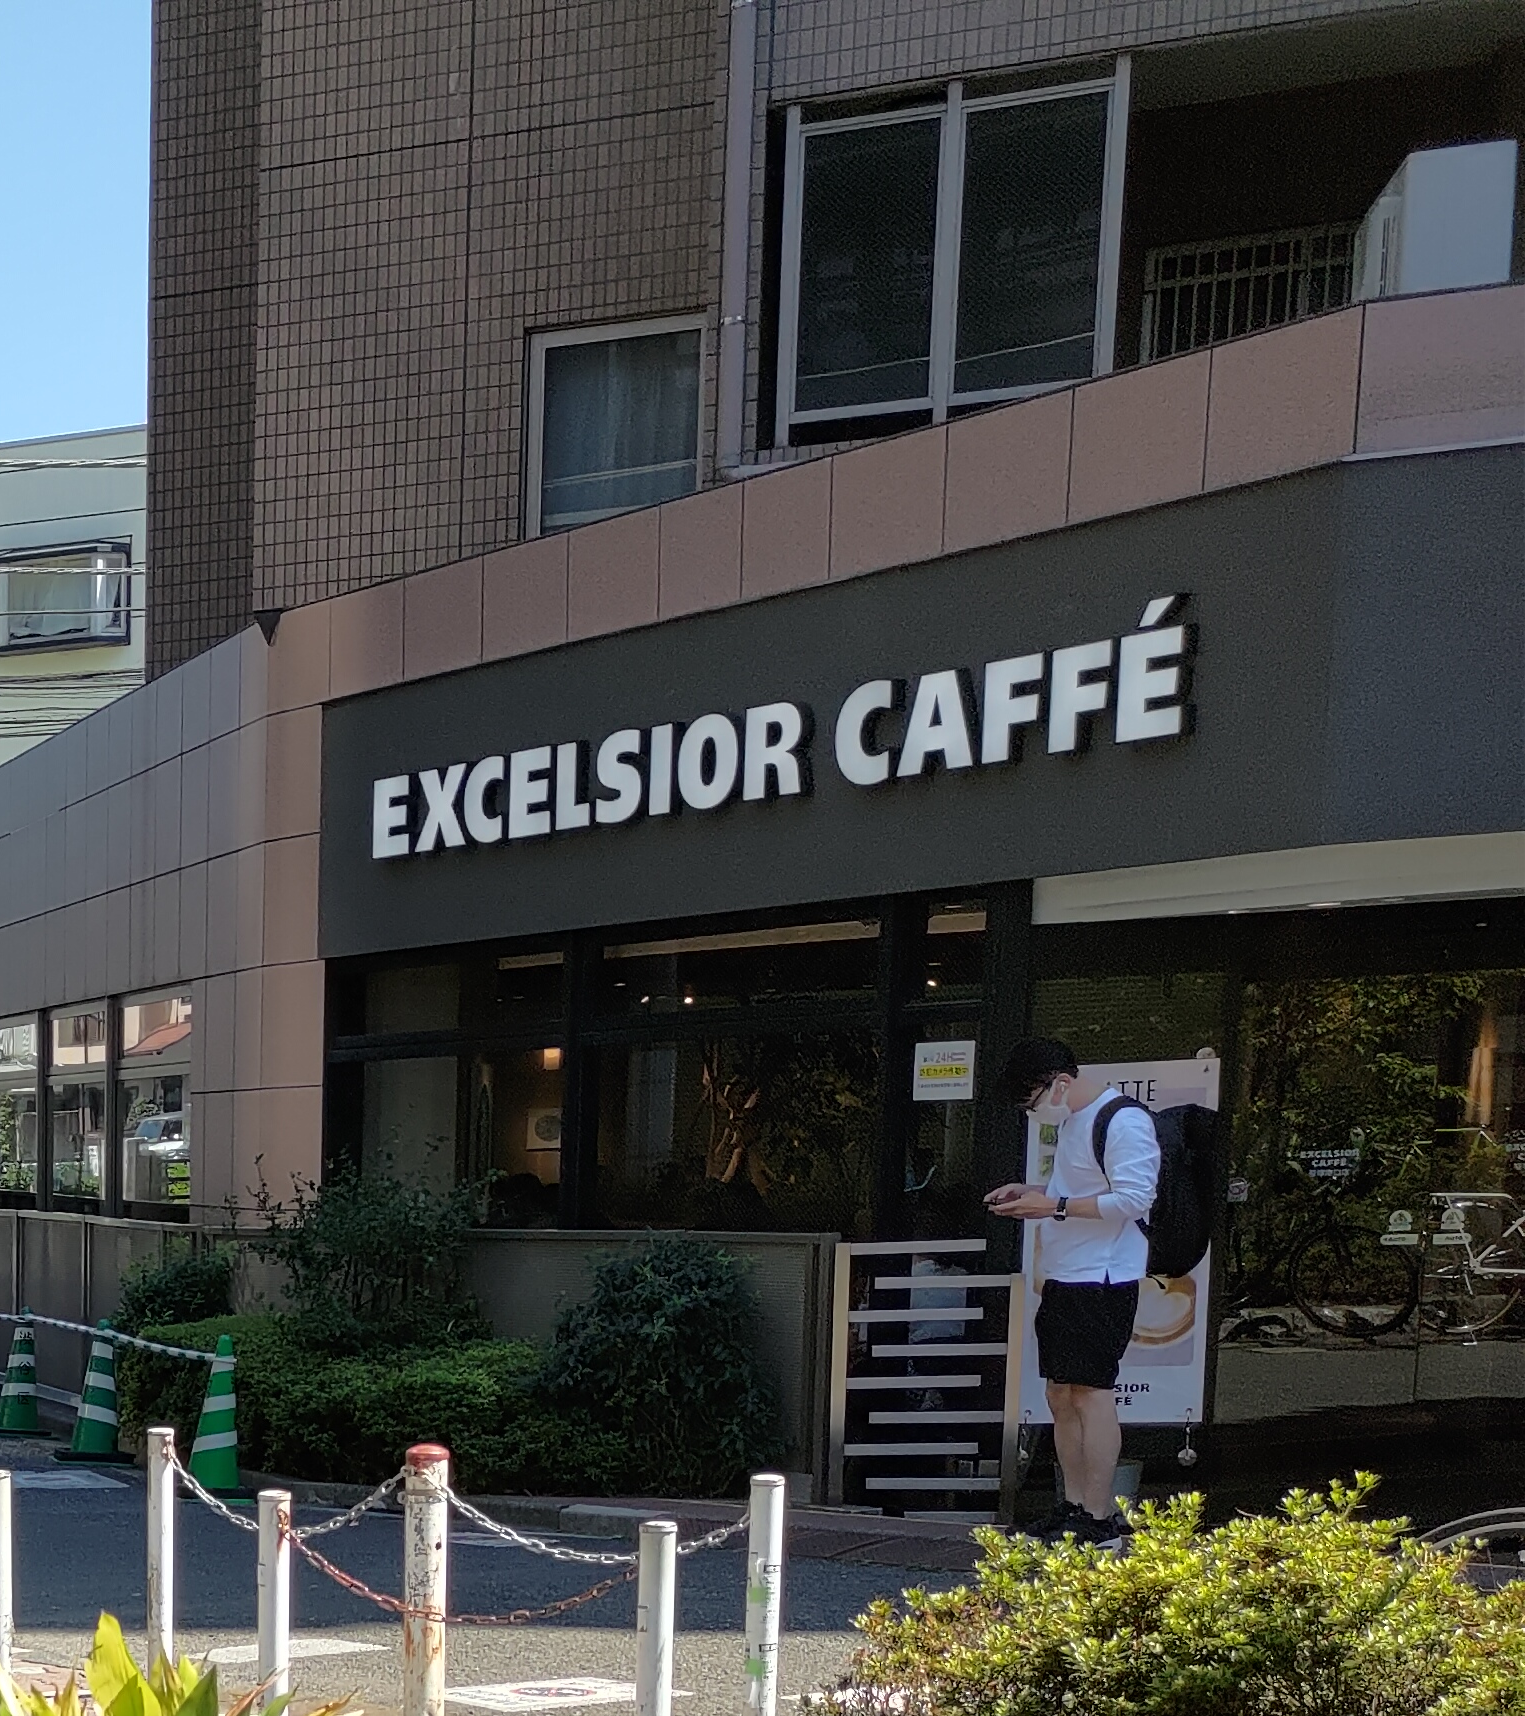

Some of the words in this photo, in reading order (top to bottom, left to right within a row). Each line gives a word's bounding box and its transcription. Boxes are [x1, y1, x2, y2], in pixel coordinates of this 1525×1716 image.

[371, 700, 802, 859] EXCELSIOR
[833, 594, 1185, 787] CAFFÉ
[1106, 1078, 1157, 1102] TTE
[1299, 1148, 1360, 1159] EXCELSIOR
